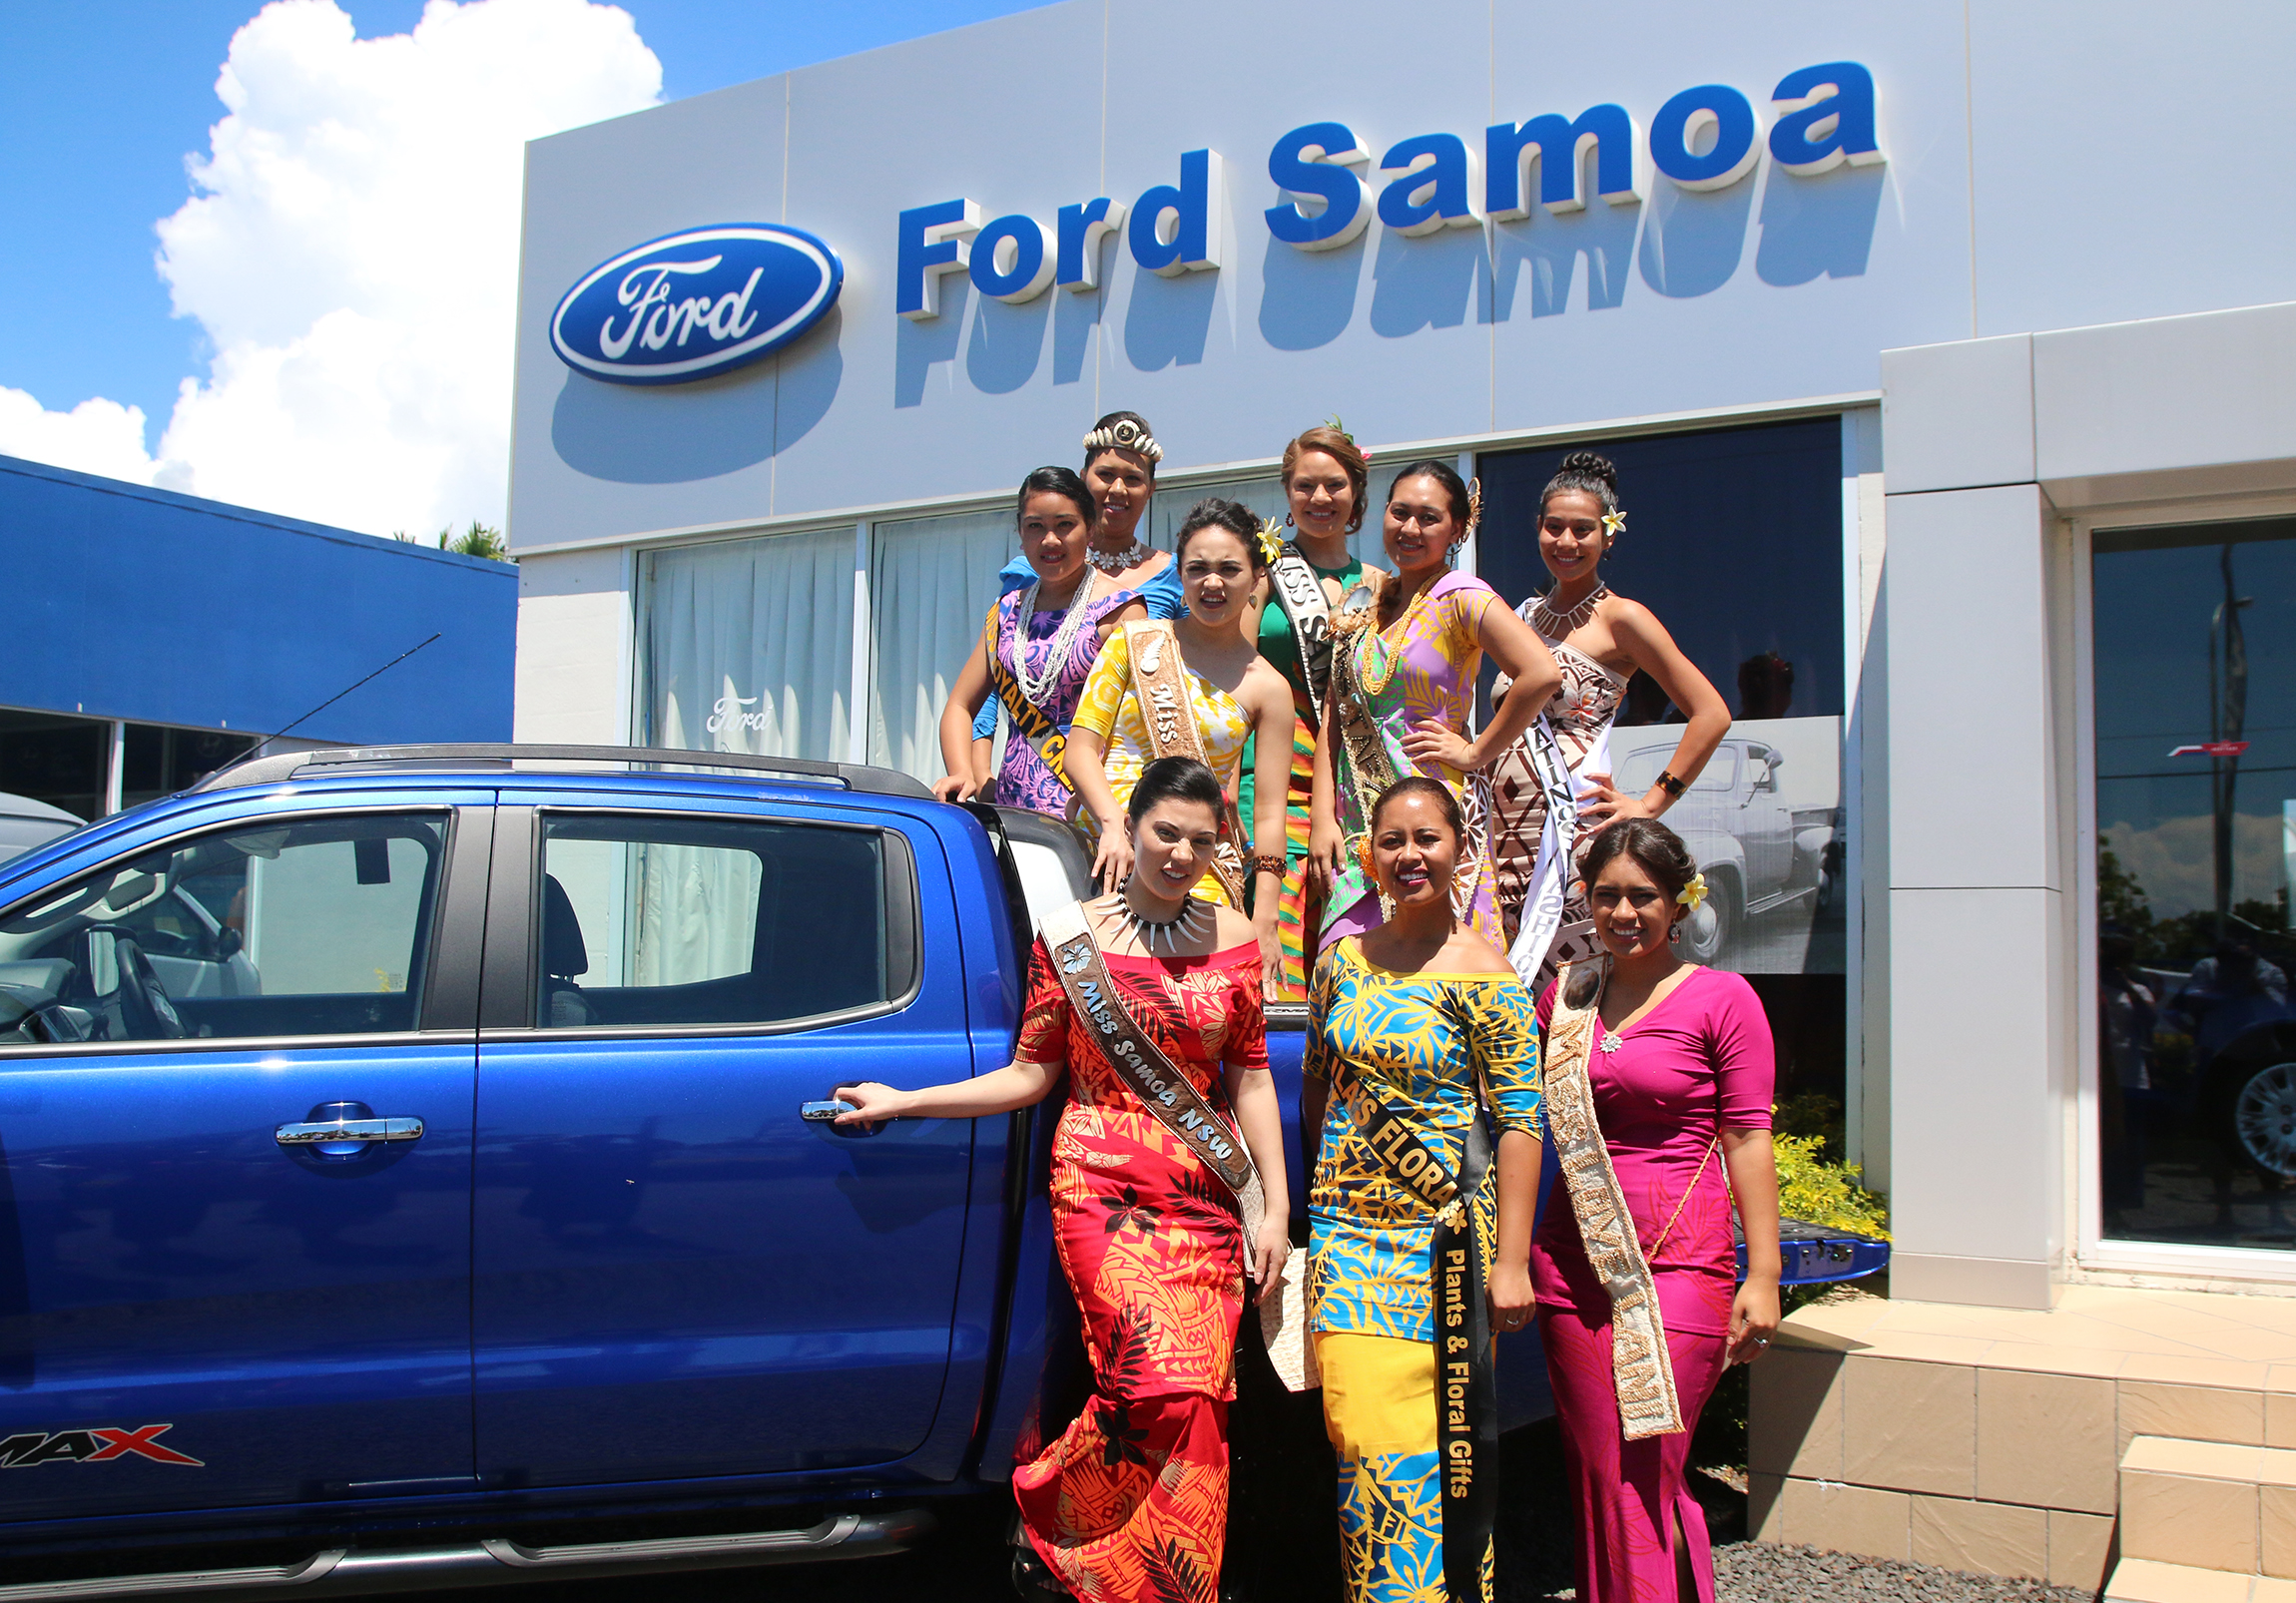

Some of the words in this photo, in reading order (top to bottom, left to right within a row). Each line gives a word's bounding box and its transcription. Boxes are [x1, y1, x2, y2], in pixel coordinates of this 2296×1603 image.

[896, 148, 1222, 321] Ford
[1264, 61, 1887, 253] Samoa
[600, 254, 765, 360] Ford
[706, 696, 775, 733] Ford
[1150, 683, 1179, 744] Miss
[1113, 1039, 1178, 1107] Samoa
[1177, 1108, 1234, 1160] NSW
[1546, 1012, 1589, 1145] MISS
[1611, 1290, 1665, 1420] LANI
[1445, 1249, 1467, 1328] Plants
[1446, 1335, 1469, 1354] &
[1446, 1361, 1471, 1432] Floral
[1448, 1439, 1472, 1498] Gifts
